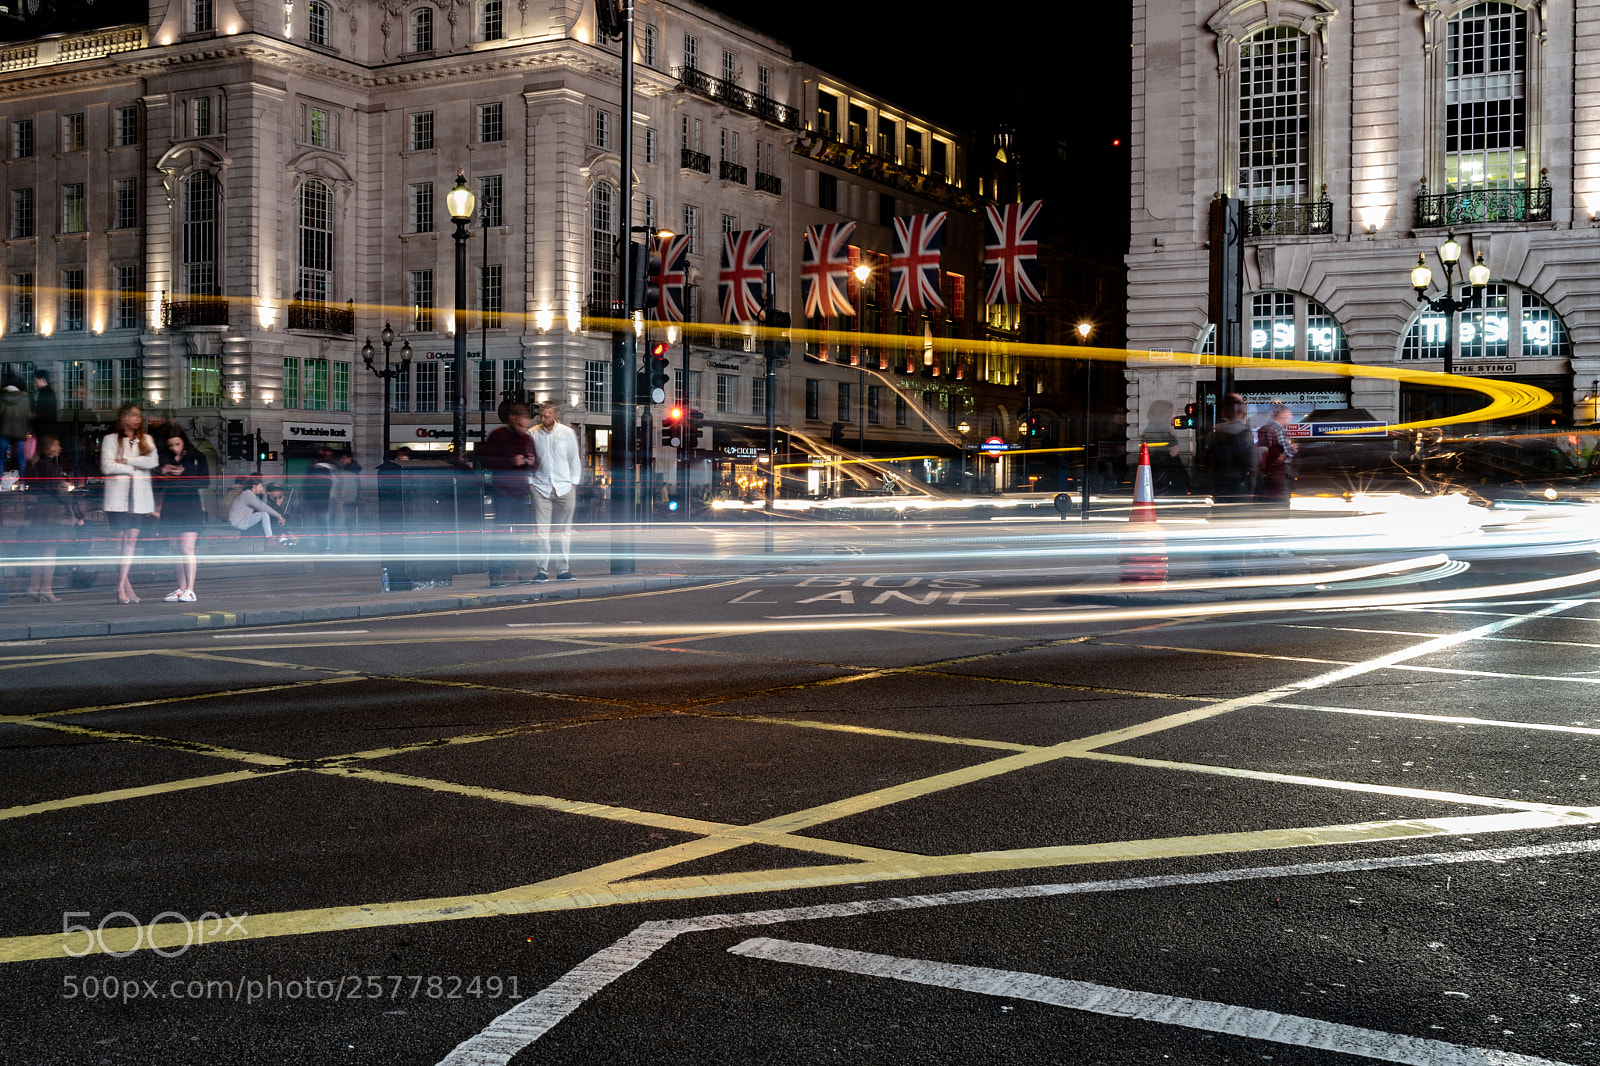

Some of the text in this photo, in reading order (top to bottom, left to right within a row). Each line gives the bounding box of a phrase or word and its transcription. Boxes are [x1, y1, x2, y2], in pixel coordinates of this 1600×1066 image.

[1477, 364, 1513, 372] STING
[301, 427, 347, 437] Yorkshire Bank
[794, 576, 983, 589] BUS
[727, 589, 1010, 606] LANE
